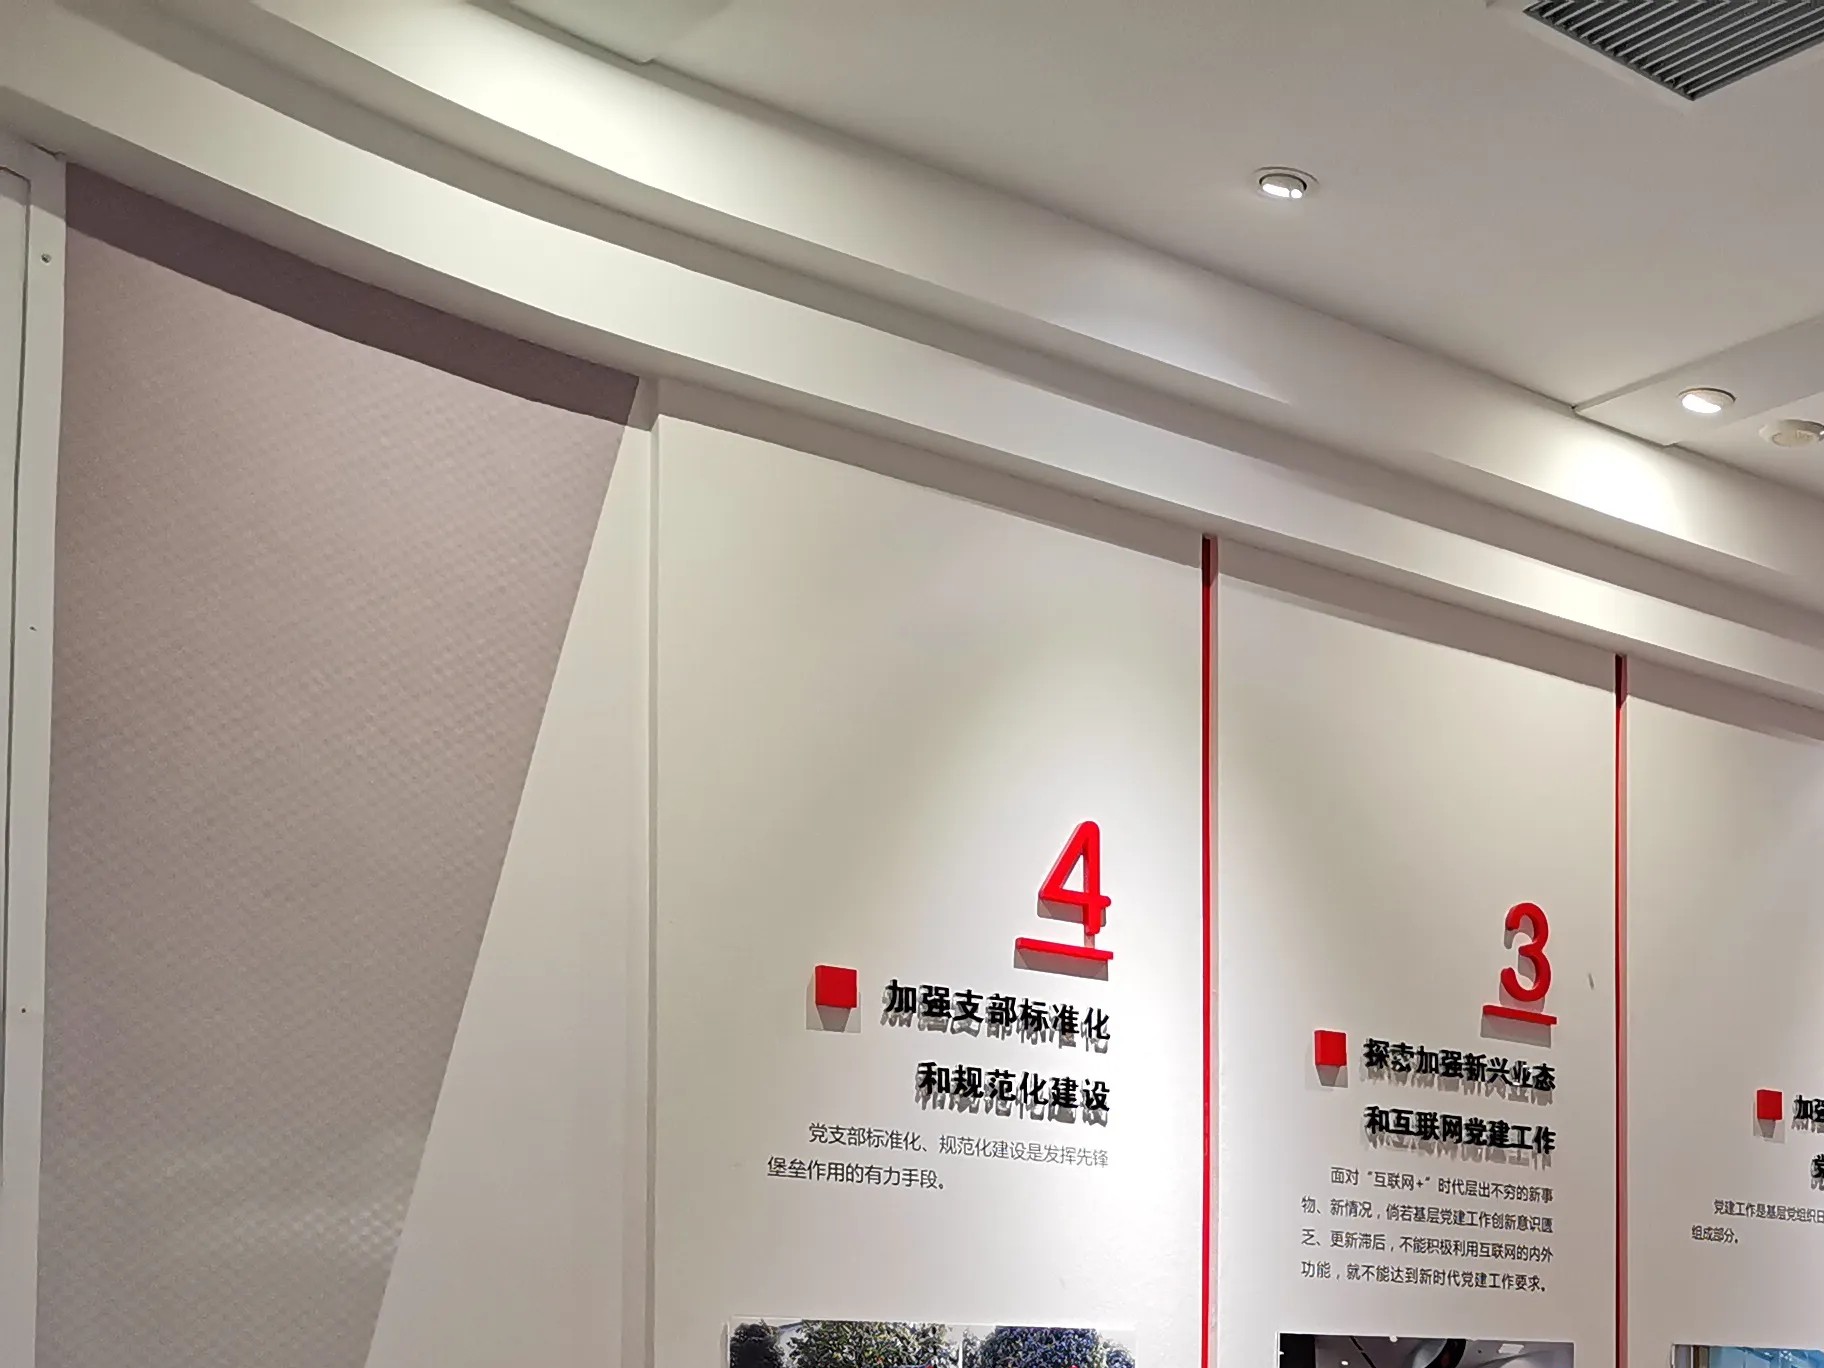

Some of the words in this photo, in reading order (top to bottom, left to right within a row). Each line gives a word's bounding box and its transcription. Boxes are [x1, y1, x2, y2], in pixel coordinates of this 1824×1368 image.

[1038, 820, 1111, 935] 4
[1501, 902, 1552, 1001] 3
[886, 979, 1111, 1041] 加强支部标准化
[918, 1061, 1111, 1111] 和规范化建设
[1363, 1038, 1556, 1091] 探索加强新兴业态
[809, 1123, 1109, 1168] 党支部标准化、规范化建设是发挥先锋
[1365, 1106, 1556, 1154] 和互联网党建工作
[767, 1156, 944, 1190] 堡垒作用的有力手段。
[1691, 1226, 1739, 1244] 组成部分。
